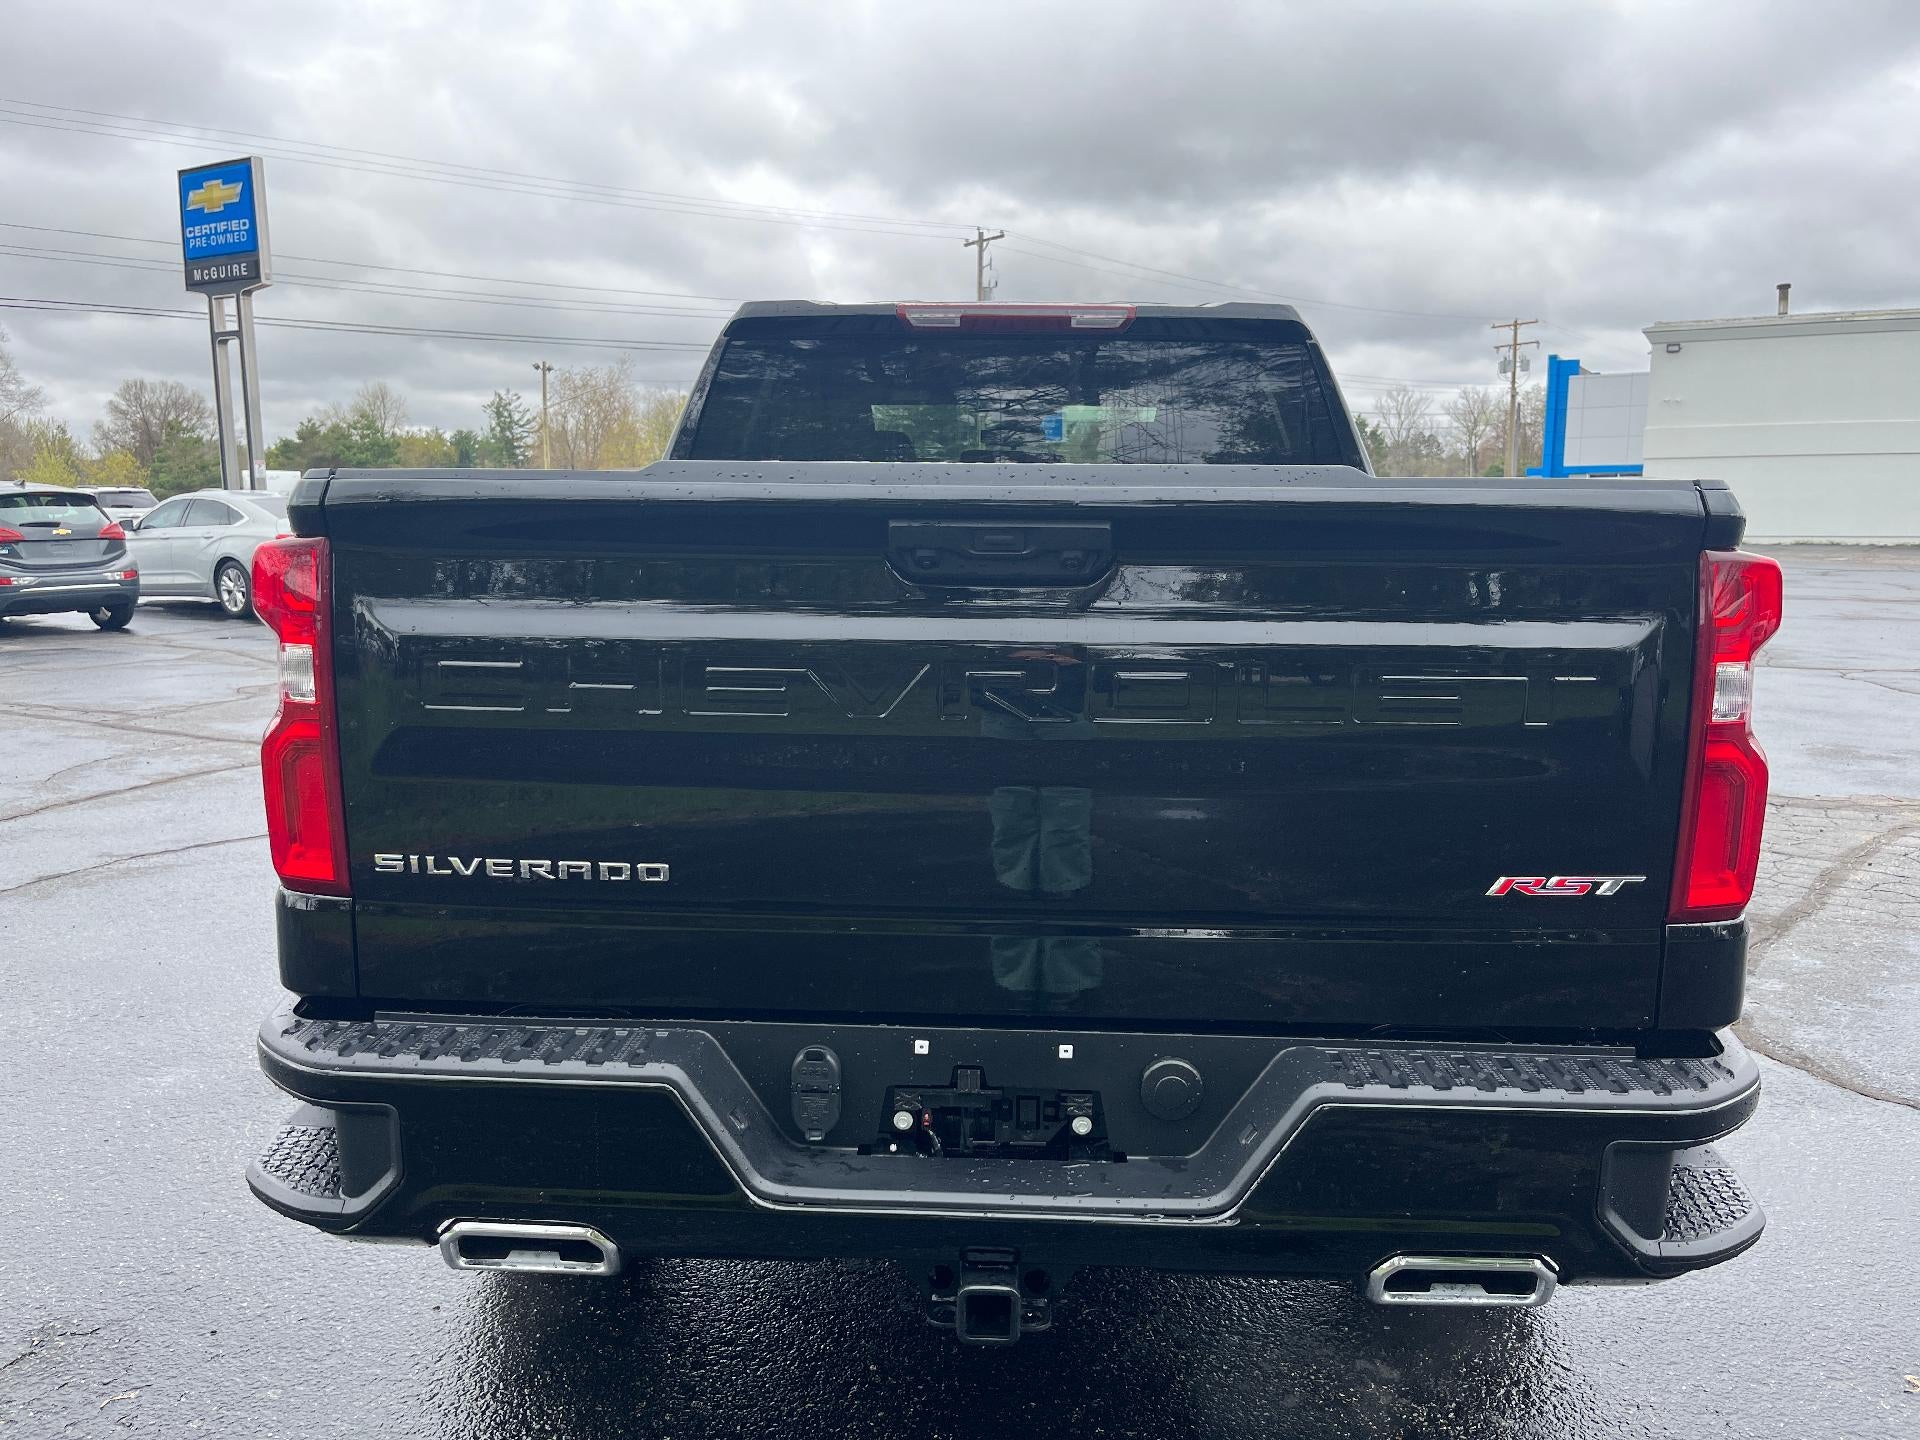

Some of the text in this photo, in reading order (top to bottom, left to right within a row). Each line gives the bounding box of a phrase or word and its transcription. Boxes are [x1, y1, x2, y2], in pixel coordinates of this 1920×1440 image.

[186, 219, 249, 238] CERTIFIED
[189, 231, 247, 249] PRE-OWNED
[193, 263, 248, 281] McGUIRE
[418, 660, 1599, 727] CHEVROLET
[374, 853, 670, 882] SILVERADO
[1485, 876, 1647, 896] RST
